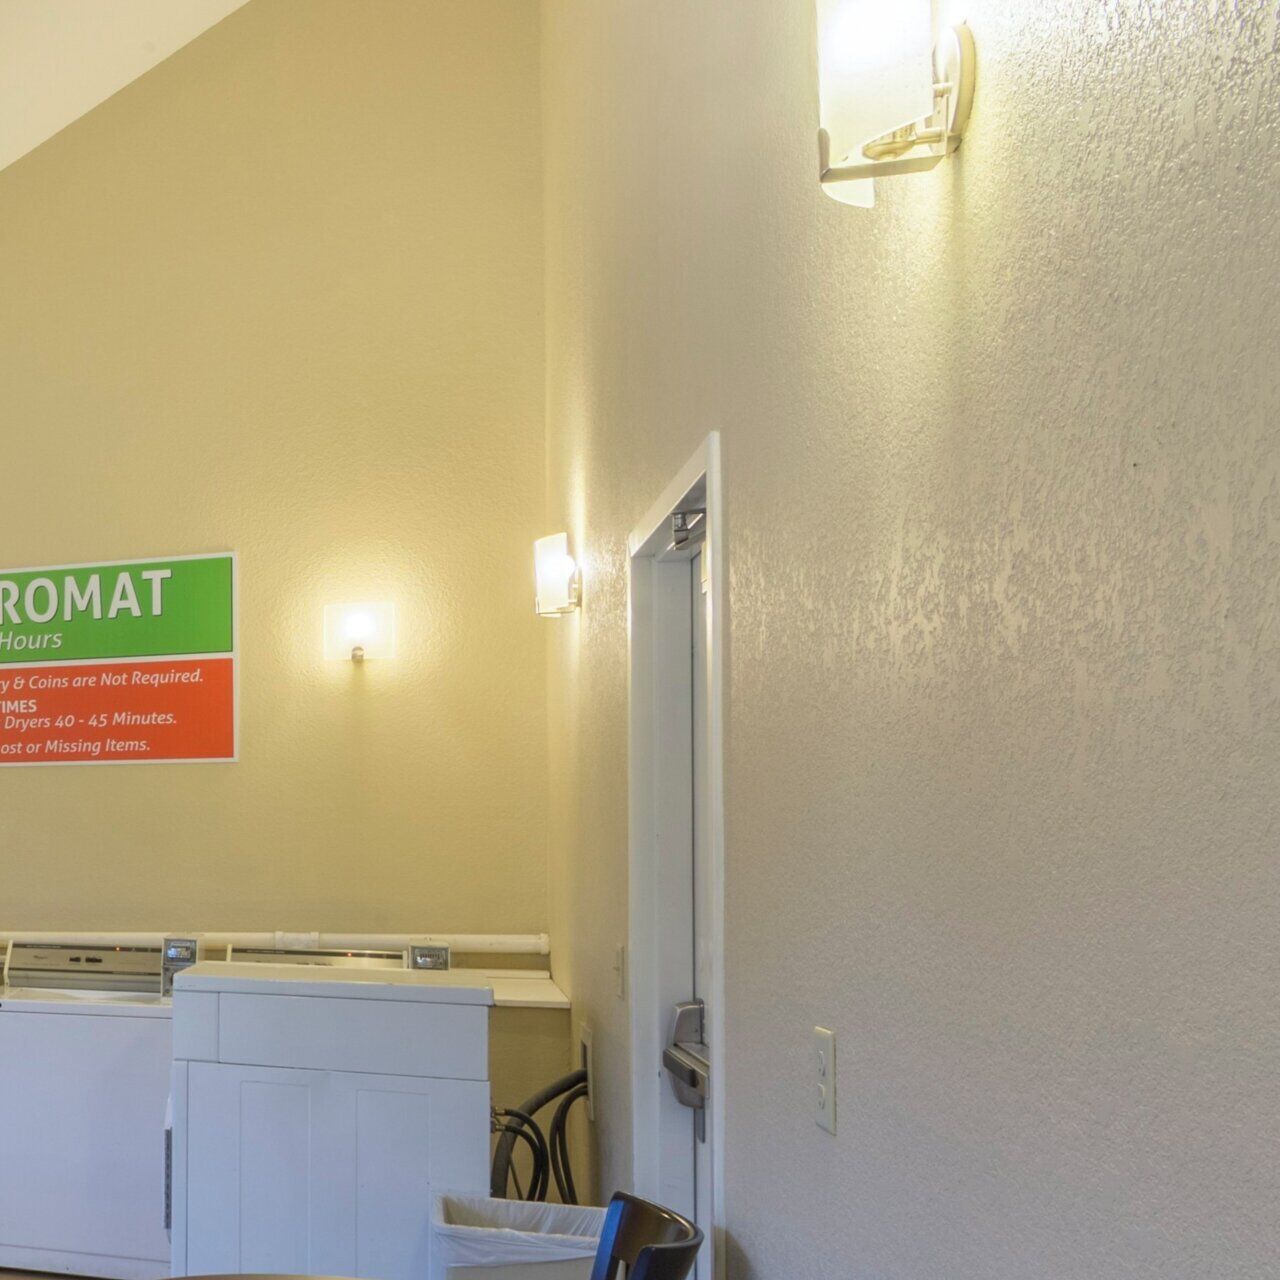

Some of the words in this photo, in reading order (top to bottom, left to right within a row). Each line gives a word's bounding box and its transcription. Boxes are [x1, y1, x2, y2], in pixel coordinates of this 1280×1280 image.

[13, 676, 25, 690] &
[29, 674, 69, 689] Coins
[72, 675, 96, 687] are
[100, 672, 128, 687] Not
[131, 668, 204, 687] Required.
[4, 715, 51, 732] Dryers
[54, 714, 76, 728] 40
[88, 713, 109, 728] 45
[112, 711, 177, 726] Minutes.
[26, 743, 42, 754] or
[45, 738, 102, 756] Missing
[105, 737, 151, 751] Items.
